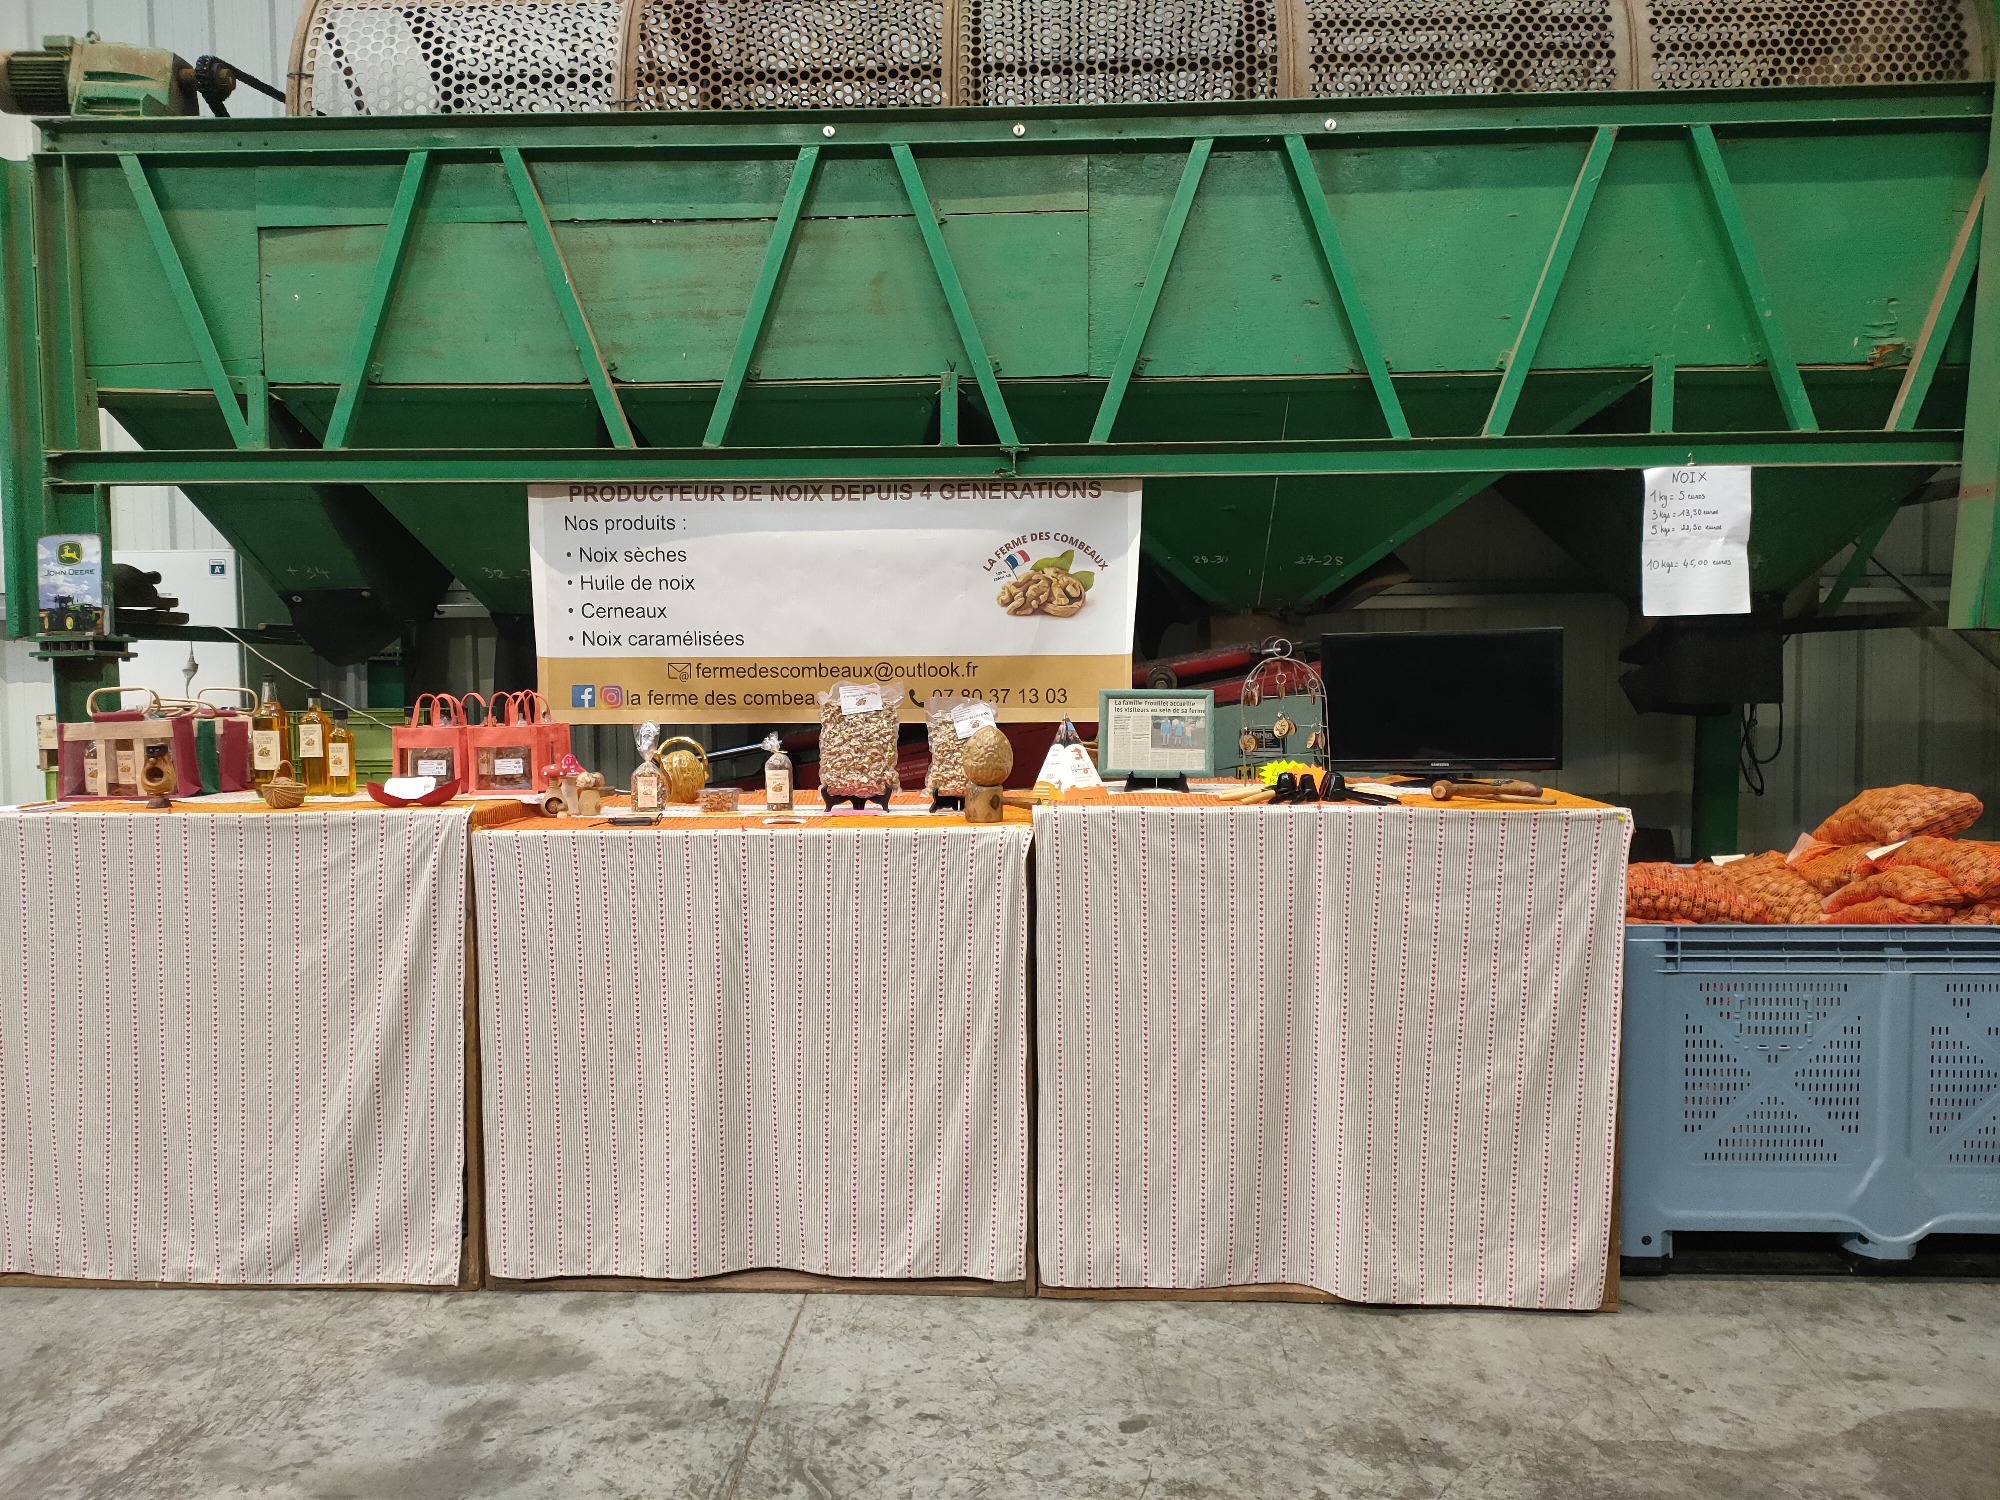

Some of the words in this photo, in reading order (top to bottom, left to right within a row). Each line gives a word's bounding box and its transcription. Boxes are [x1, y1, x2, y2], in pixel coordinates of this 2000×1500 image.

[1672, 471, 1707, 483] NOIX
[569, 484, 725, 502] PRODUCTEUR
[732, 484, 762, 501] DE
[770, 484, 824, 502] NOIX
[831, 483, 913, 502] DEPUIS
[919, 483, 932, 500] 4
[1650, 490, 1656, 502] 1
[1659, 491, 1668, 508] kg
[1678, 491, 1685, 500] 5
[1652, 510, 1658, 520] 3
[1678, 509, 1702, 518] 13,50
[564, 515, 599, 531] Nos
[605, 515, 676, 534] produits
[1651, 525, 1658, 535] 5
[1681, 524, 1702, 532] 22,50
[579, 547, 618, 562] Noix
[624, 547, 687, 562] sèches
[983, 558, 998, 572] LA
[994, 535, 1028, 559] FERME
[1030, 532, 1050, 541] DES
[1053, 532, 1109, 571] COMBEAUX
[1294, 554, 1344, 566] 27-28
[1647, 559, 1659, 570] 10
[1683, 559, 1708, 568] 45,00
[68, 568, 95, 576] DEERE
[580, 575, 625, 590] Huile
[631, 575, 652, 590] de
[659, 575, 695, 590] noix
[581, 603, 667, 619] Cerneaux
[582, 631, 622, 647] Noix
[628, 631, 745, 647] caramélisées
[695, 662, 979, 681] fermedescombeaux@outlook.fr
[626, 690, 641, 705] la
[647, 690, 699, 705] ferme
[705, 690, 737, 705] des
[743, 690, 821, 705] combea
[988, 688, 1011, 704] 37
[1018, 688, 1039, 704] 13
[1045, 688, 1068, 704] 03
